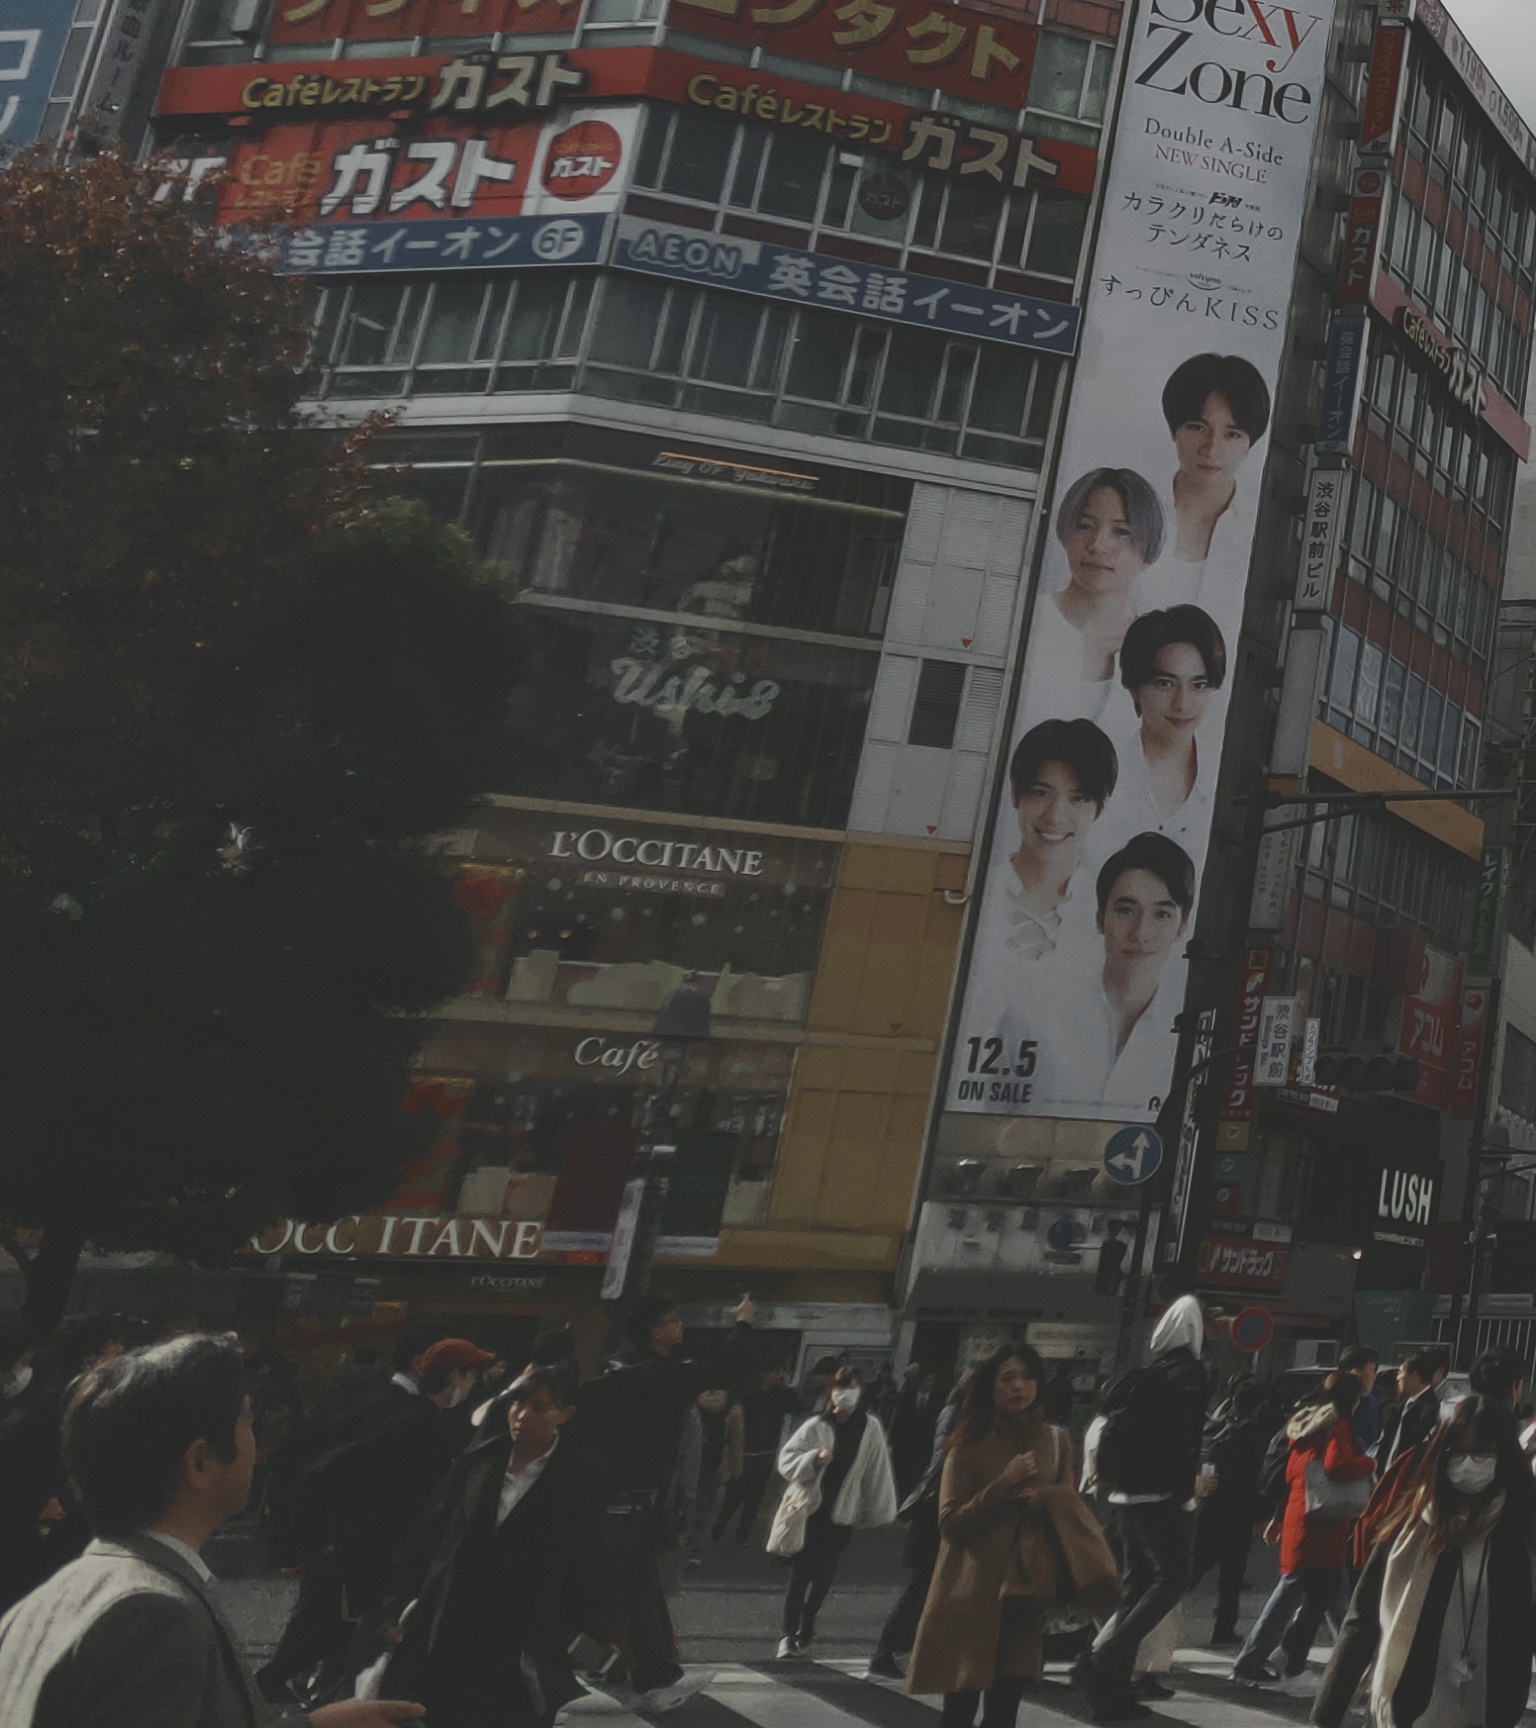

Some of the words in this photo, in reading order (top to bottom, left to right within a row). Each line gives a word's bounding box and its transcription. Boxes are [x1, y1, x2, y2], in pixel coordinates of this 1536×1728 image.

[430, 51, 585, 113] ガスト
[1134, 23, 1311, 124] Zone
[549, 154, 614, 180] ガスト
[902, 111, 1058, 189] ガスト
[1144, 117, 1214, 152] Double
[1219, 138, 1284, 168] A-Side
[1155, 143, 1200, 168] NEW
[1201, 154, 1267, 185] SINGLE
[320, 136, 517, 217] ガスト
[1122, 191, 1283, 242] カラクリだらけの
[633, 236, 744, 274] AEON
[1147, 223, 1252, 262] テンダネス
[1346, 225, 1372, 288] ガスト
[767, 253, 1070, 340] 英会話イーオン
[1300, 480, 1335, 600] 渋谷駅前ビル
[549, 828, 763, 876] L'OCCITANE
[1478, 850, 1499, 896] レイク
[573, 1035, 661, 1072] Café
[965, 1035, 1038, 1079] 12.5
[1267, 1003, 1291, 1079] 渋谷駅前
[1456, 1039, 1479, 1091] アコム
[957, 1079, 988, 1102] ON
[988, 1081, 1032, 1105] SALE
[1377, 1167, 1434, 1226] LUSH
